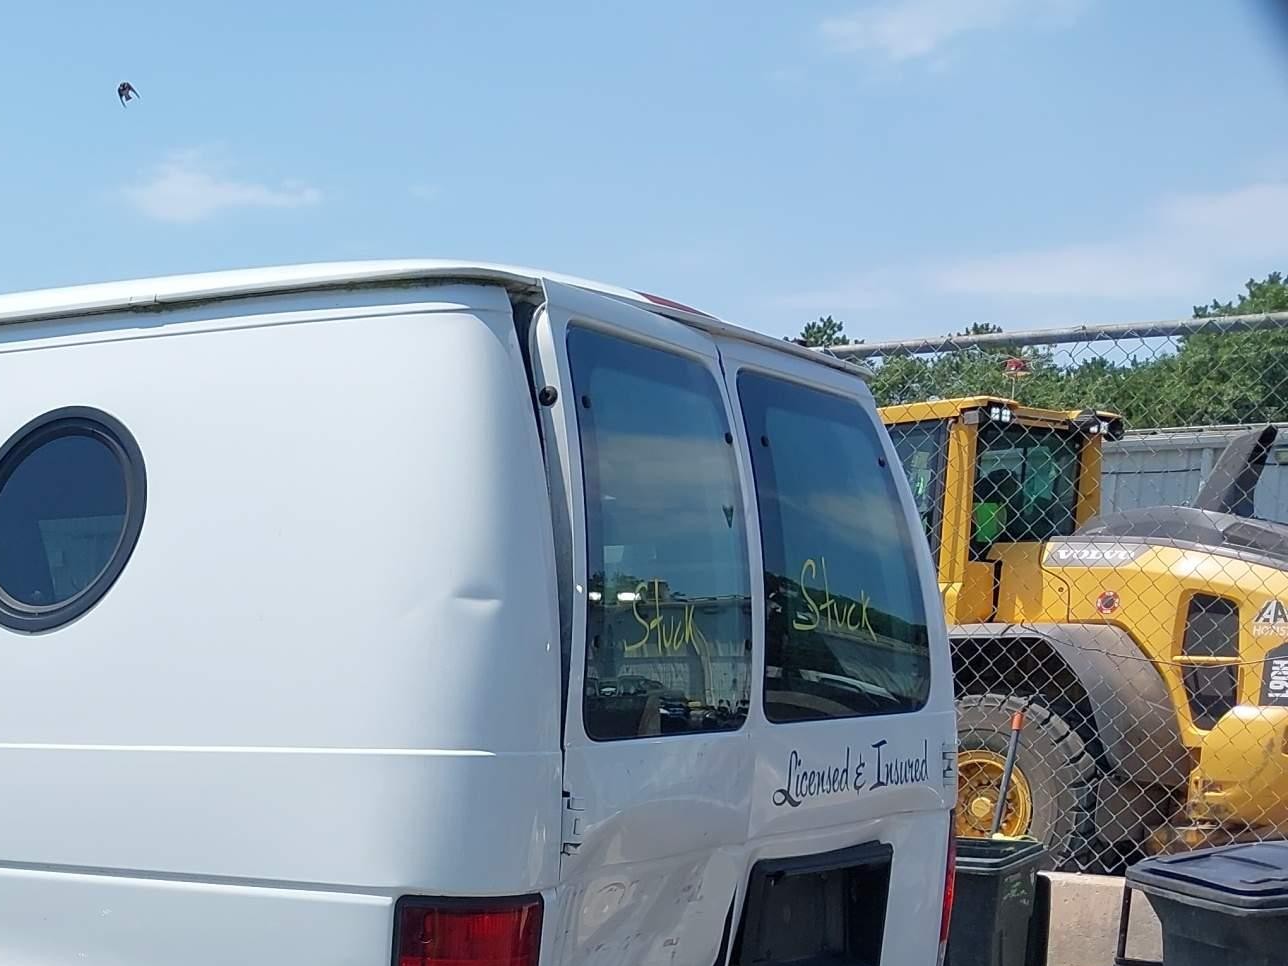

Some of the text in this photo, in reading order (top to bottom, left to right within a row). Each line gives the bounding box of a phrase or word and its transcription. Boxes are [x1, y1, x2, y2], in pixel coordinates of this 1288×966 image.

[624, 578, 701, 654] Stuck
[793, 556, 877, 642] Stuck
[773, 739, 929, 807] Licensed & Insured
